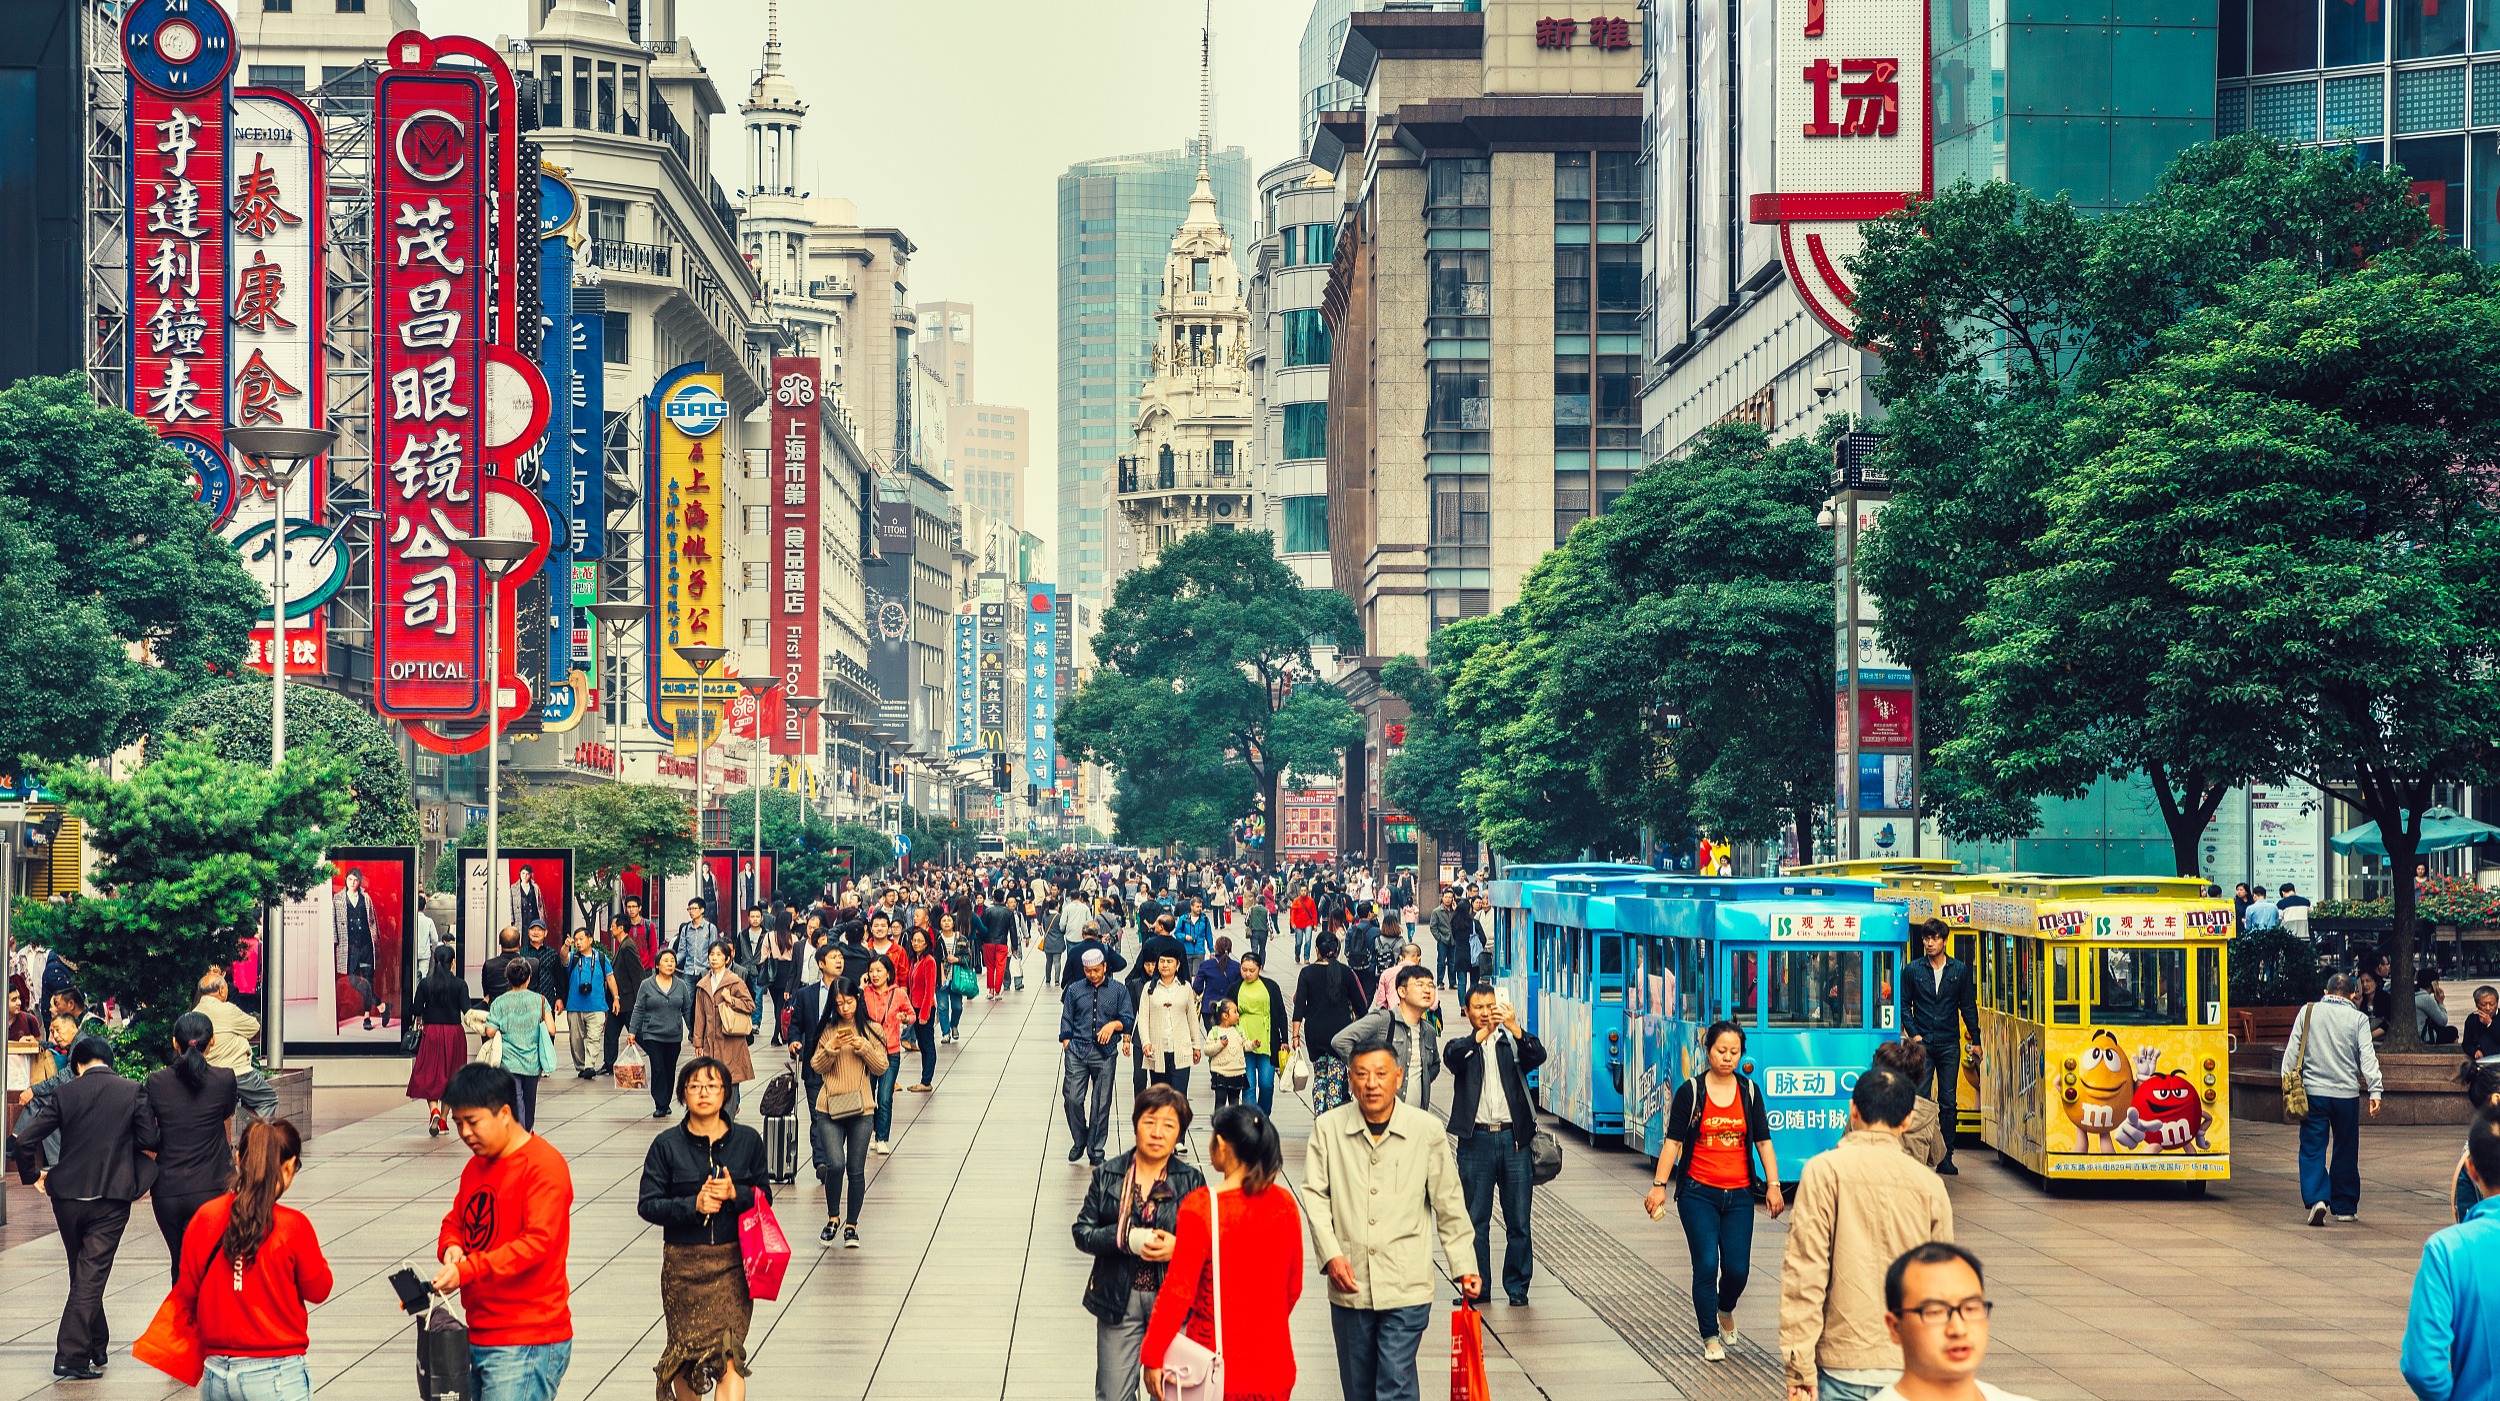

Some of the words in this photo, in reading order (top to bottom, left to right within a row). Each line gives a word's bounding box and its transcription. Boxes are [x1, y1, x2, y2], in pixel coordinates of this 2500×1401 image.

[131, 33, 149, 45] IX
[1535, 16, 1631, 50] 新雅
[169, 70, 187, 84] VI
[390, 197, 471, 636] 茂昌眼镜公司
[666, 402, 728, 417] BAC
[784, 417, 807, 614] 上海市第一食品商店
[883, 525, 908, 535] TITONI
[786, 625, 802, 660] First
[390, 661, 469, 680] OPTICAL
[1801, 915, 1856, 929] 观光车
[2120, 915, 2177, 929] 观光车
[2116, 929, 2131, 938] City
[2136, 929, 2177, 937] Sightseeing
[1884, 1008, 1891, 1026] 5
[2210, 1004, 2218, 1022] 7
[1775, 1072, 1826, 1095] 脉动
[2081, 1101, 2114, 1128] m
[2160, 1118, 2193, 1147] m
